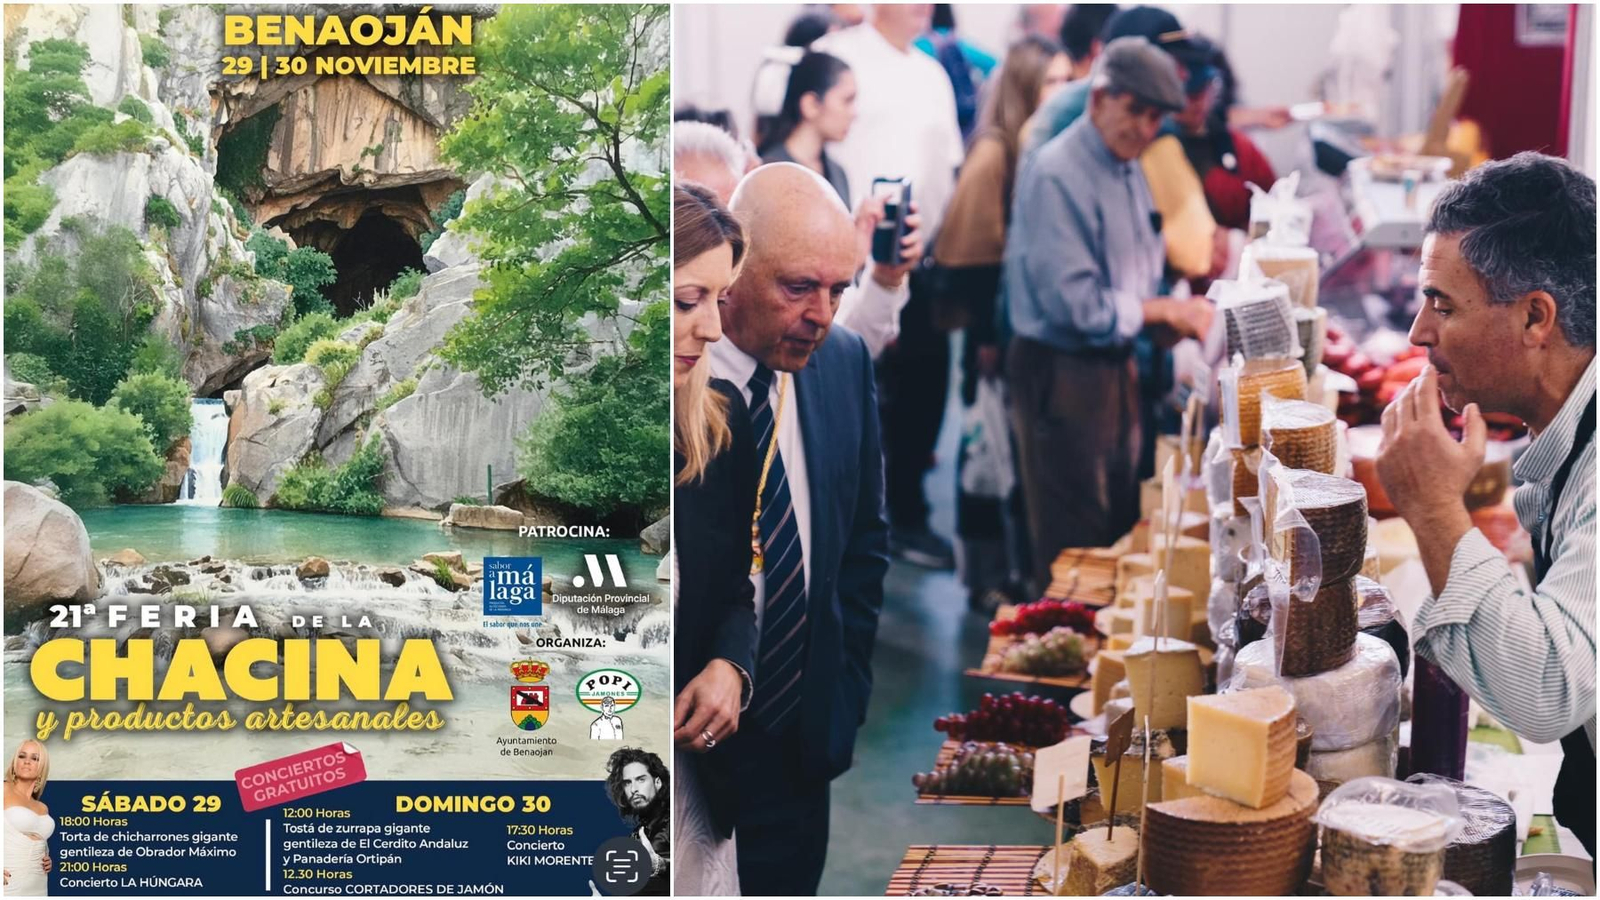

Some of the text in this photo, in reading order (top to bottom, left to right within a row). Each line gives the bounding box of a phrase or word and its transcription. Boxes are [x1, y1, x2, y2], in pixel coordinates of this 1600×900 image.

[224, 6, 472, 46] BENAOJÁN
[222, 56, 253, 75] 29
[275, 56, 308, 75] 30
[316, 56, 475, 75] NOVIEMBRE
[518, 525, 610, 538] PATROCINA:
[489, 561, 512, 570] sabor
[552, 593, 650, 605] Diputación Provincial
[109, 604, 259, 628] FERIA
[292, 615, 323, 628] DE
[342, 615, 373, 628] LA
[577, 604, 625, 616] de Málaga
[536, 638, 606, 648] ORGANIZA:
[30, 637, 454, 702] CHACINA
[586, 675, 632, 691] POPI
[36, 703, 446, 741] y productos artesanales
[496, 737, 557, 747] Ayuntamiento
[500, 748, 553, 758] de Benaojan
[241, 751, 346, 789] CONCIERTOS
[254, 768, 346, 802] GRATUITOS
[82, 791, 221, 813] SÁBADO 29
[397, 796, 552, 813] DOMINGO 30
[283, 808, 351, 819] 12:00 Horas
[60, 816, 128, 827] 18:00 Horas
[283, 822, 430, 837] Tostá de zurrapa gigante
[507, 825, 574, 835] 17:30 Horas
[60, 831, 238, 845] Torta de chicharrones gigante
[507, 839, 565, 850] Concierto
[283, 838, 468, 852] gentileza de El Cerdito Andaluz
[60, 845, 236, 859] gentileza de Obrador Máximo
[60, 861, 128, 872] 21:00 Horas
[283, 853, 402, 867] y Panadería Ortipán
[507, 855, 594, 866] KIKI MORENTE
[283, 868, 352, 880] 12.30 Horas
[60, 875, 204, 888] Concierto LA HÚNGARA
[283, 882, 504, 895] Concurso CORTADORES DE JAMÓN
